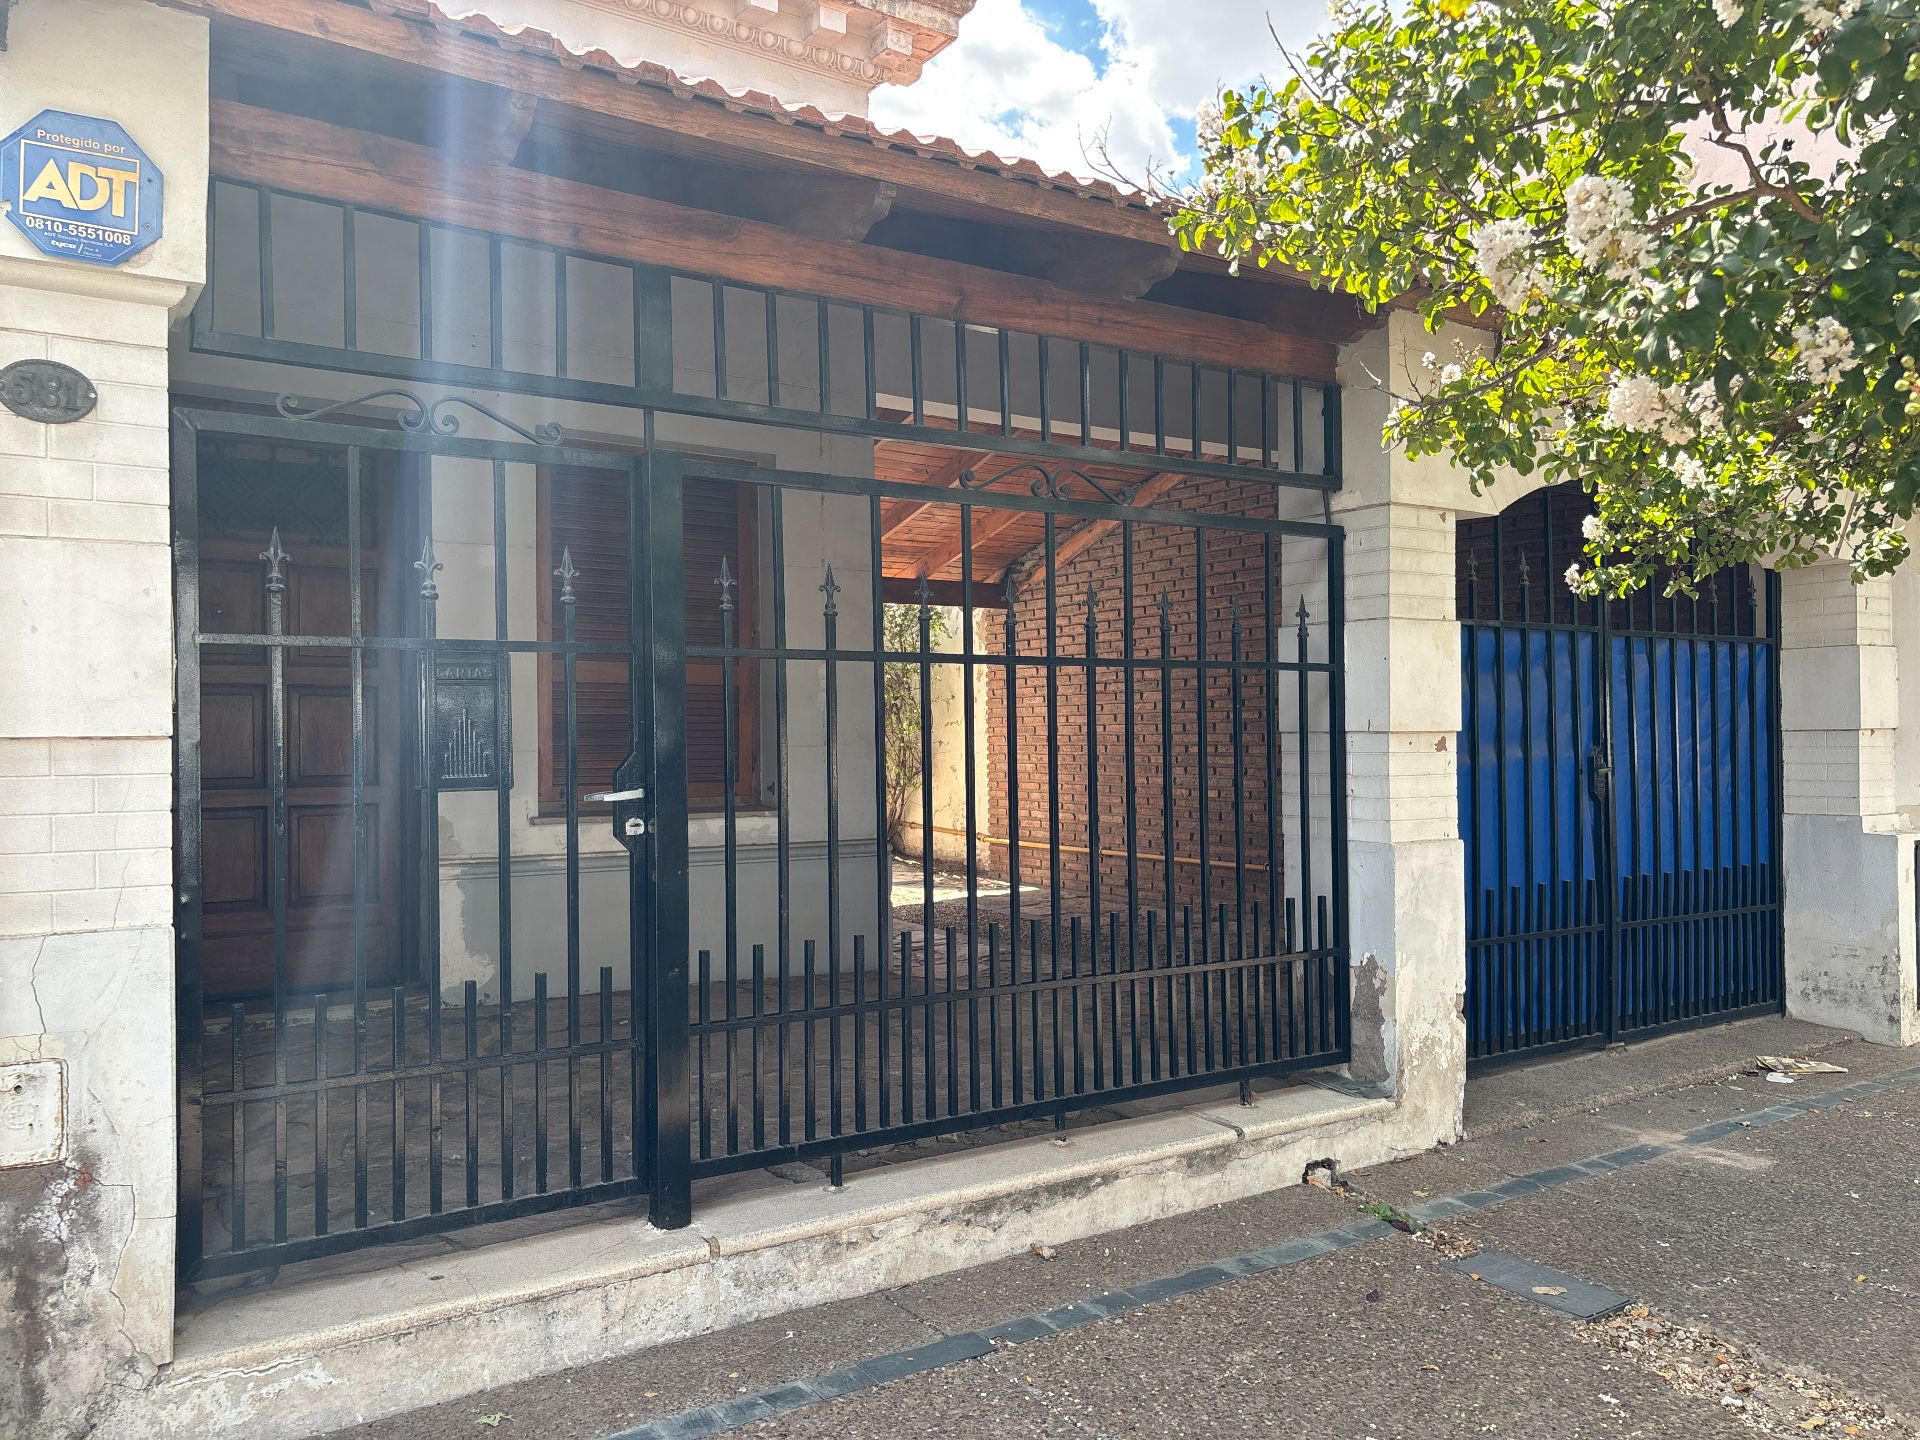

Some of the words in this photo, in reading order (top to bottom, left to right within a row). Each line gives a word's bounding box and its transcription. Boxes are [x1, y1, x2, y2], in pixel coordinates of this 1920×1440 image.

[36, 128, 101, 150] Protegido
[103, 142, 126, 155] por
[22, 158, 139, 218] ADT
[25, 216, 132, 246] 0810-5551008
